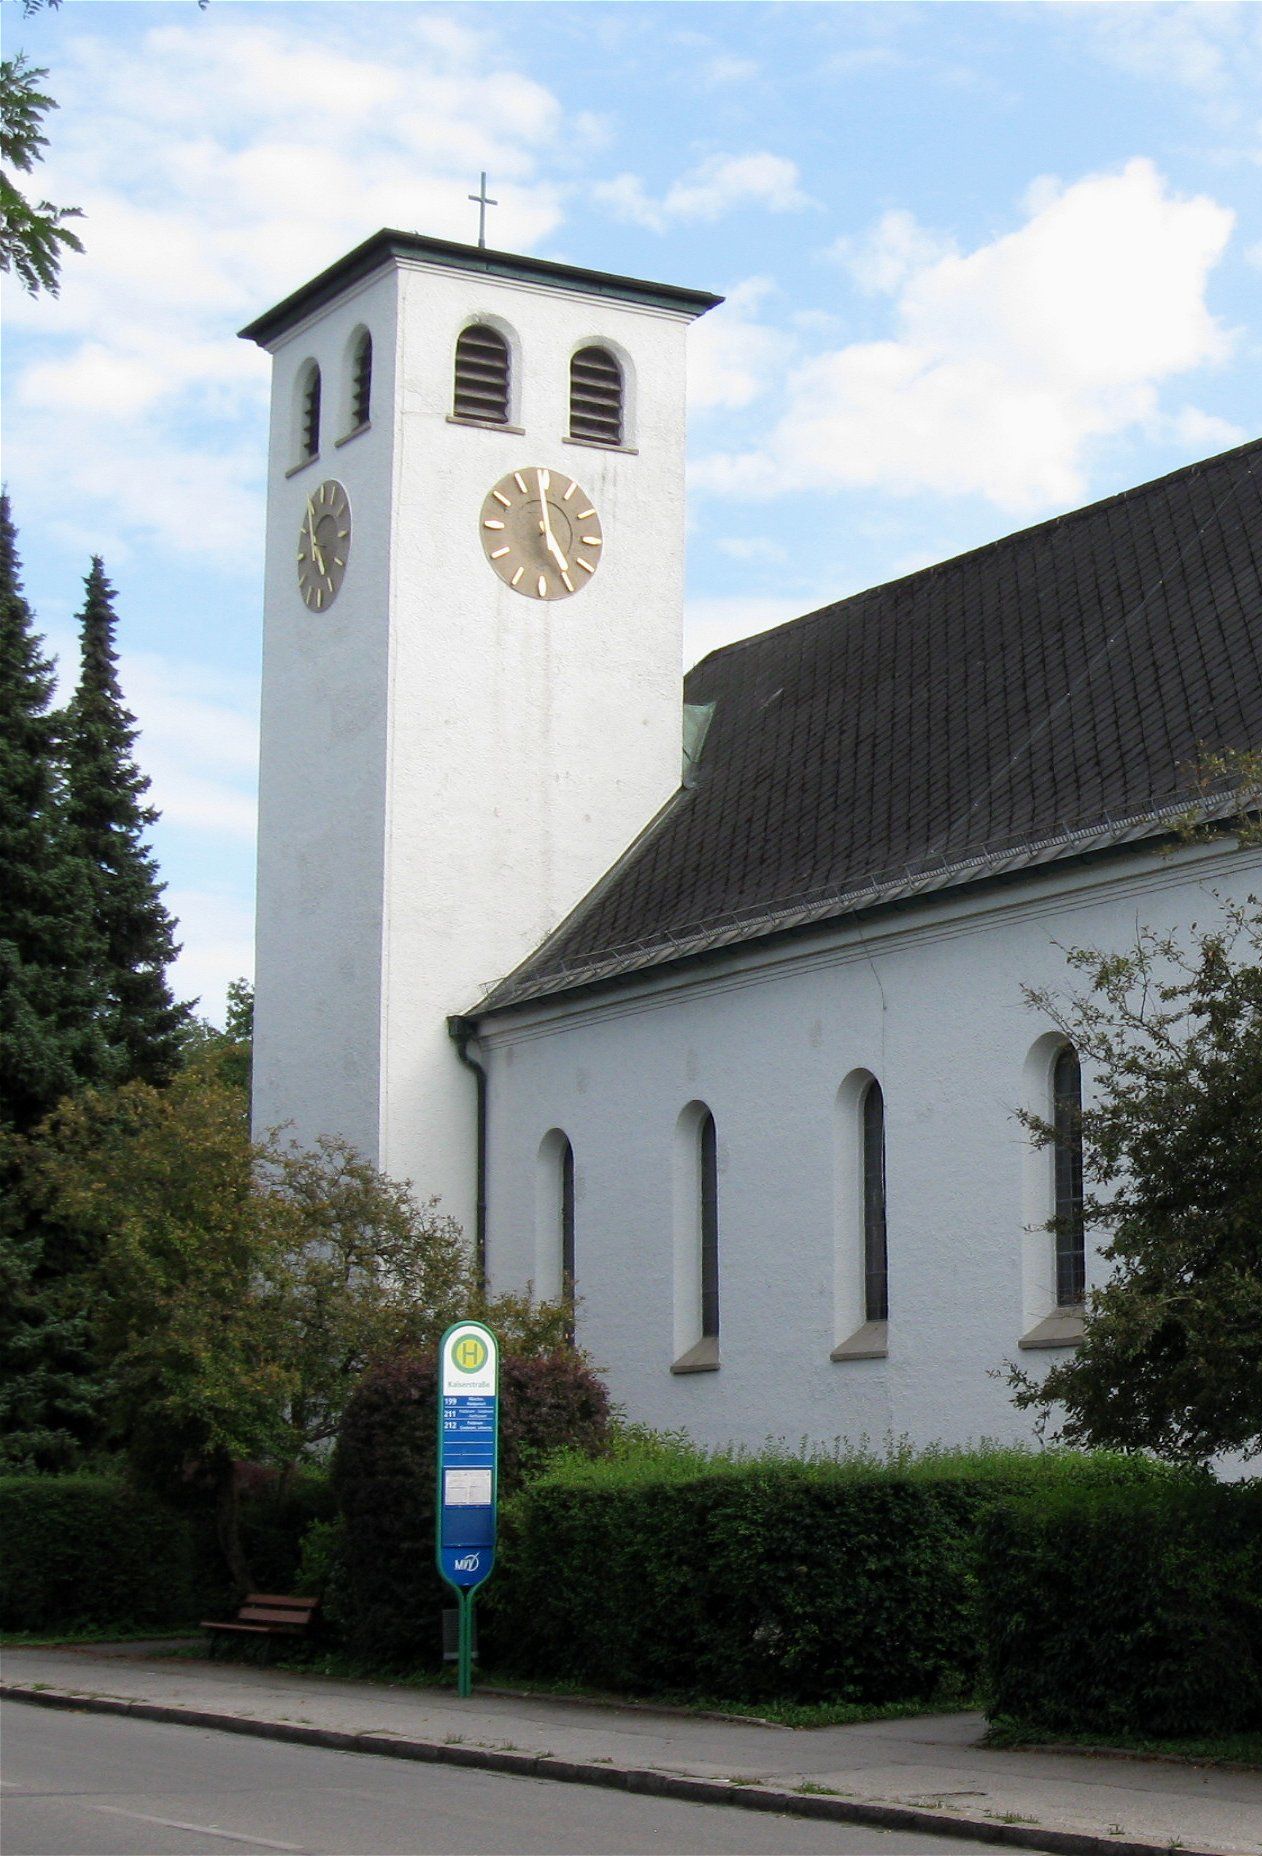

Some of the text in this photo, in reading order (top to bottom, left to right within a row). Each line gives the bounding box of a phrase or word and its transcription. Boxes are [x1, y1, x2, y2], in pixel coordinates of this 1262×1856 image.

[463, 1343, 477, 1365] H
[444, 1397, 457, 1405] 199
[444, 1410, 456, 1418] 211
[444, 1421, 457, 1429] 212
[454, 1555, 477, 1571] MVV
